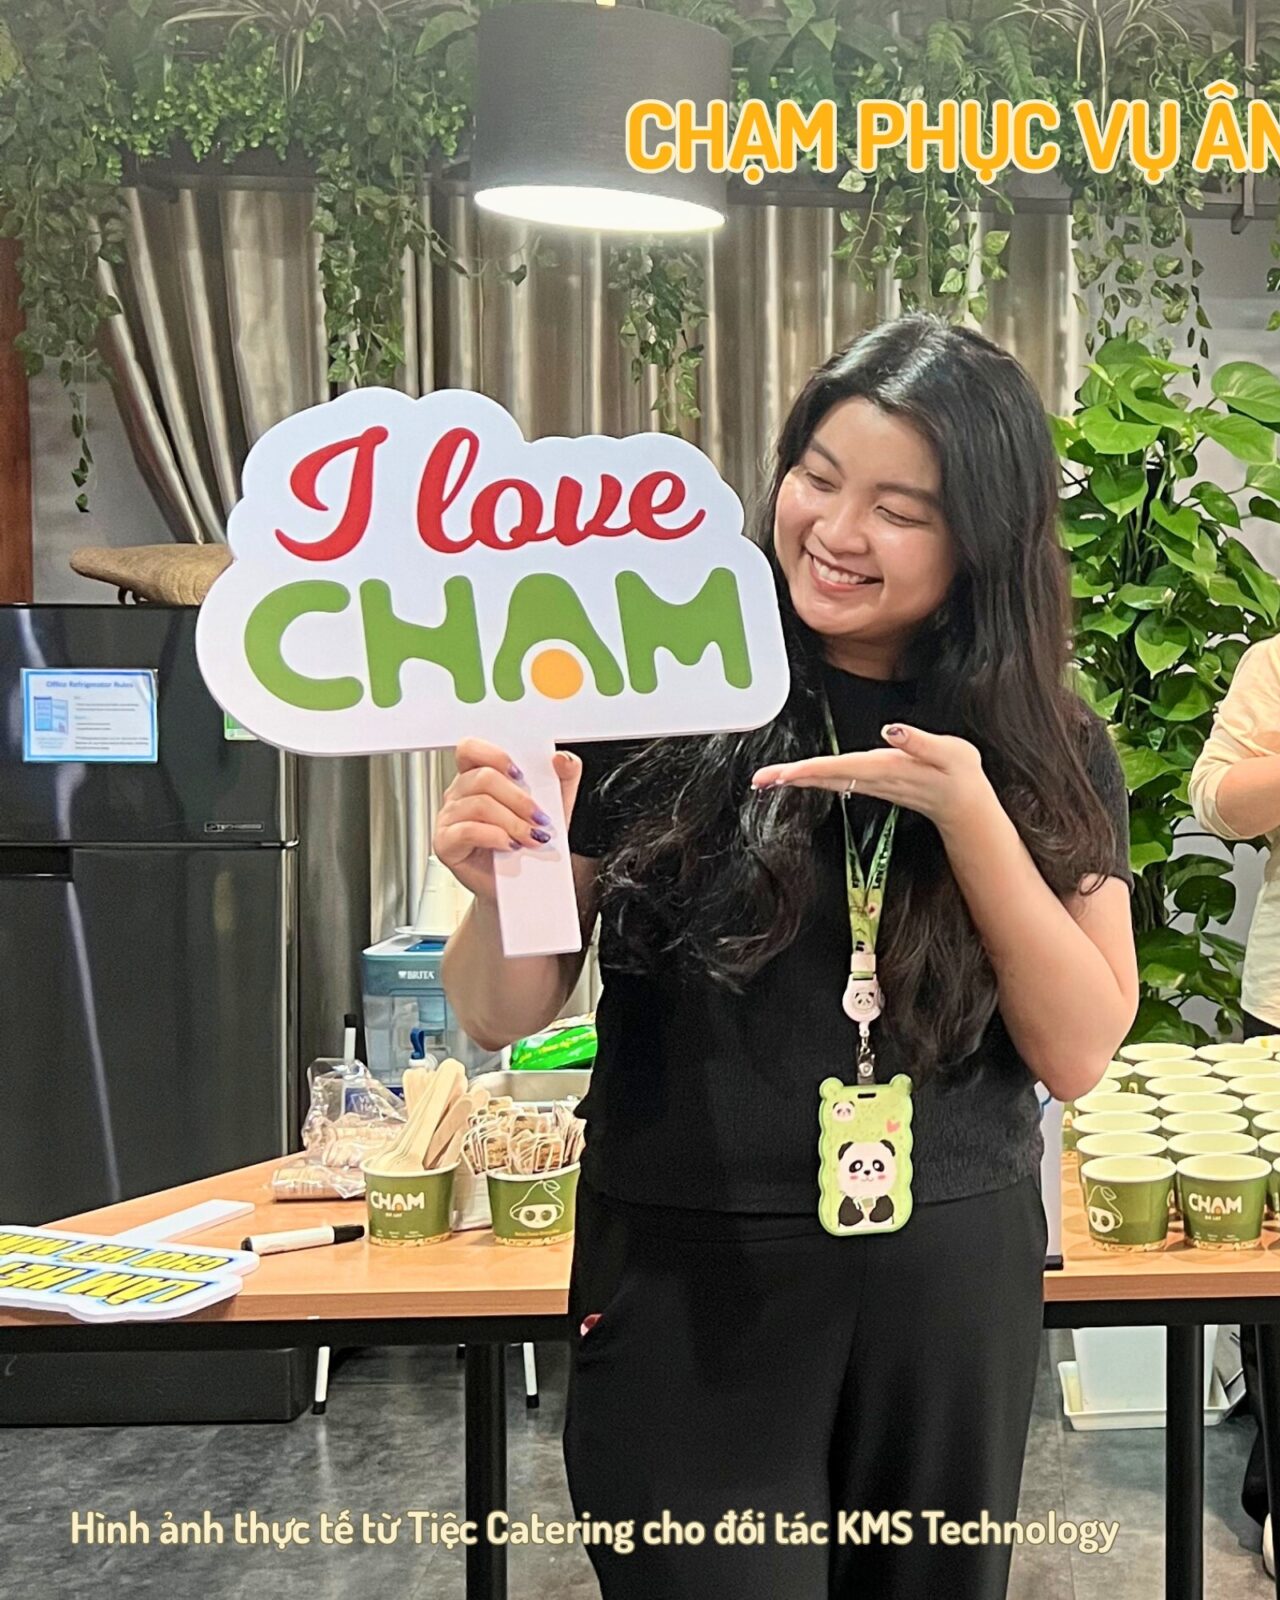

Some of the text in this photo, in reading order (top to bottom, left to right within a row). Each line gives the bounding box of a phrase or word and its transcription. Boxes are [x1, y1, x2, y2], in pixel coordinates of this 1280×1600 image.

[275, 426, 706, 562] I love
[244, 567, 752, 711] CHAM
[407, 970, 435, 980] BRITA
[370, 1190, 425, 1211] CHAM
[1188, 1192, 1242, 1214] CHAM
